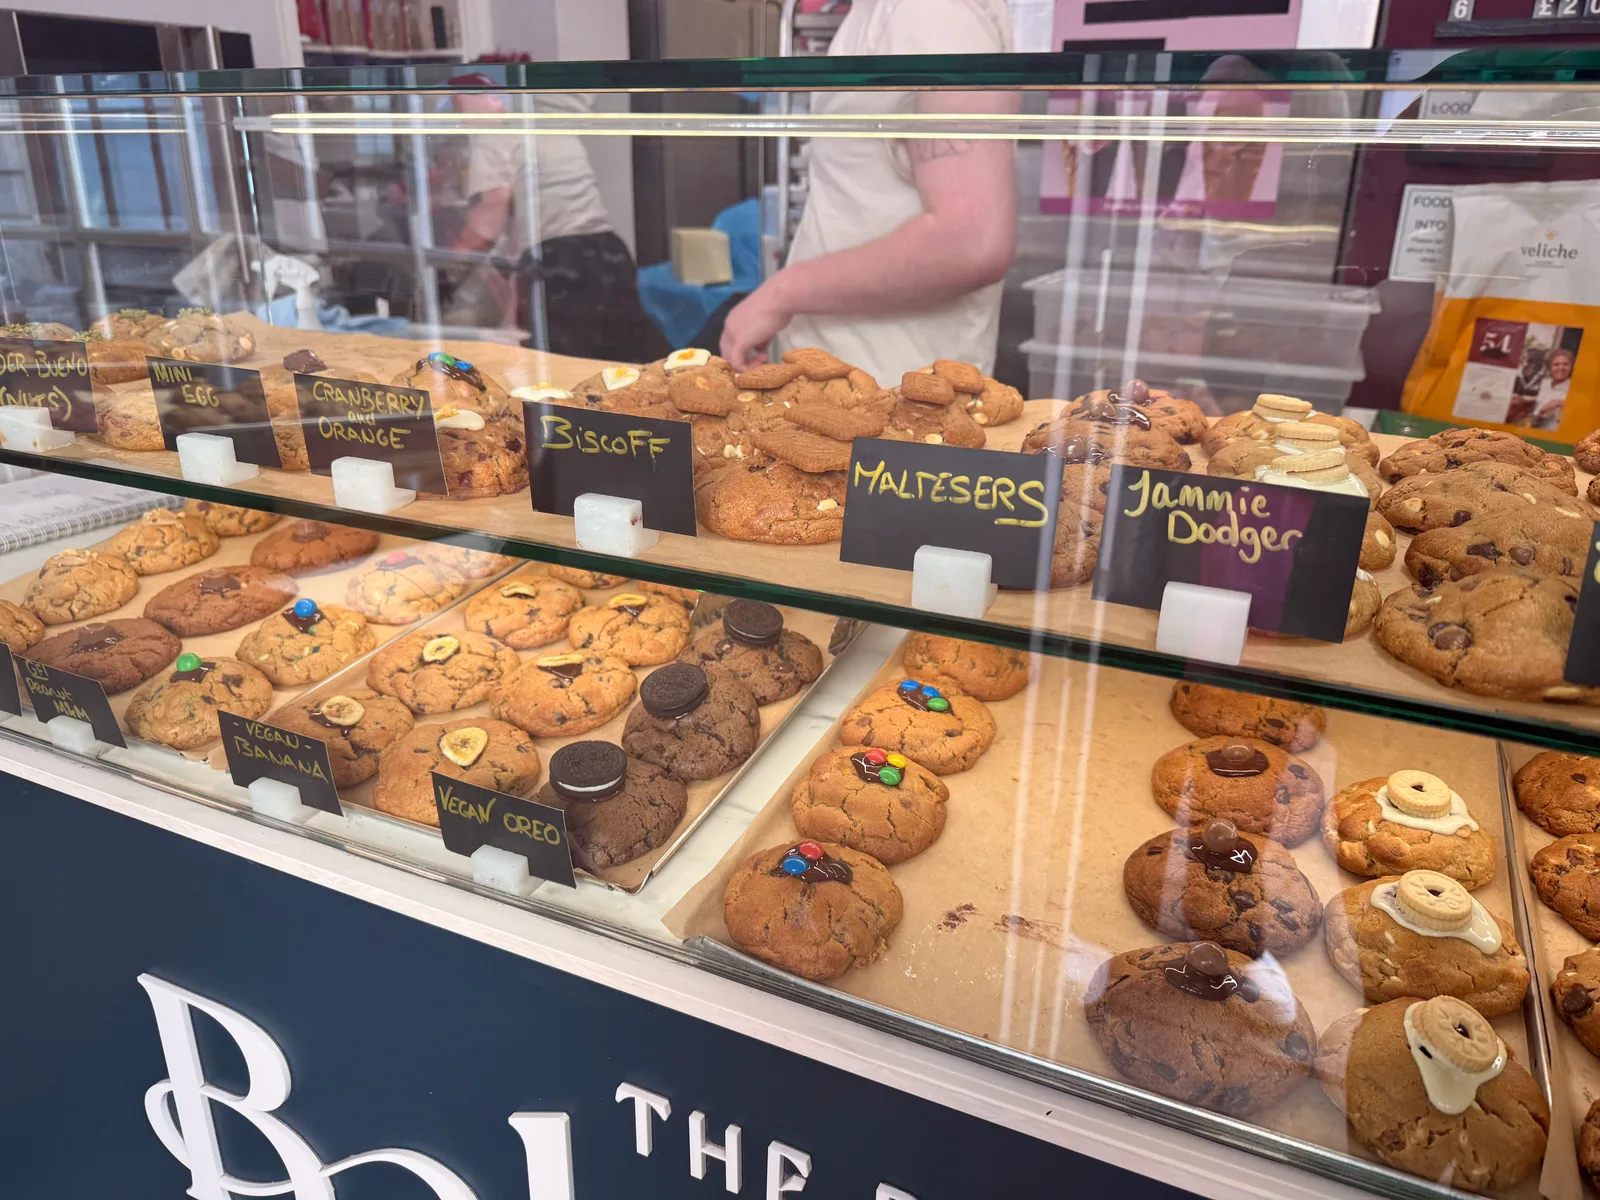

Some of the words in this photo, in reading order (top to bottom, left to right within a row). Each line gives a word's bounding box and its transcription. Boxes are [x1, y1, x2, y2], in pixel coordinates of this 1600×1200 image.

[1520, 243, 1578, 260] veliche
[35, 350, 87, 379] BUENO
[152, 361, 192, 383] MINI
[182, 384, 220, 408] EGG
[313, 381, 425, 420] CRANBERRY
[318, 416, 412, 449] ORANGE
[854, 460, 1049, 528] MALTESERS
[1123, 470, 1271, 518] Jammie
[1167, 510, 1303, 564] Dodger
[246, 722, 299, 749] VEGAN
[233, 735, 329, 784] BANANA
[438, 785, 497, 825] VEGAN
[503, 812, 561, 846] OREO
